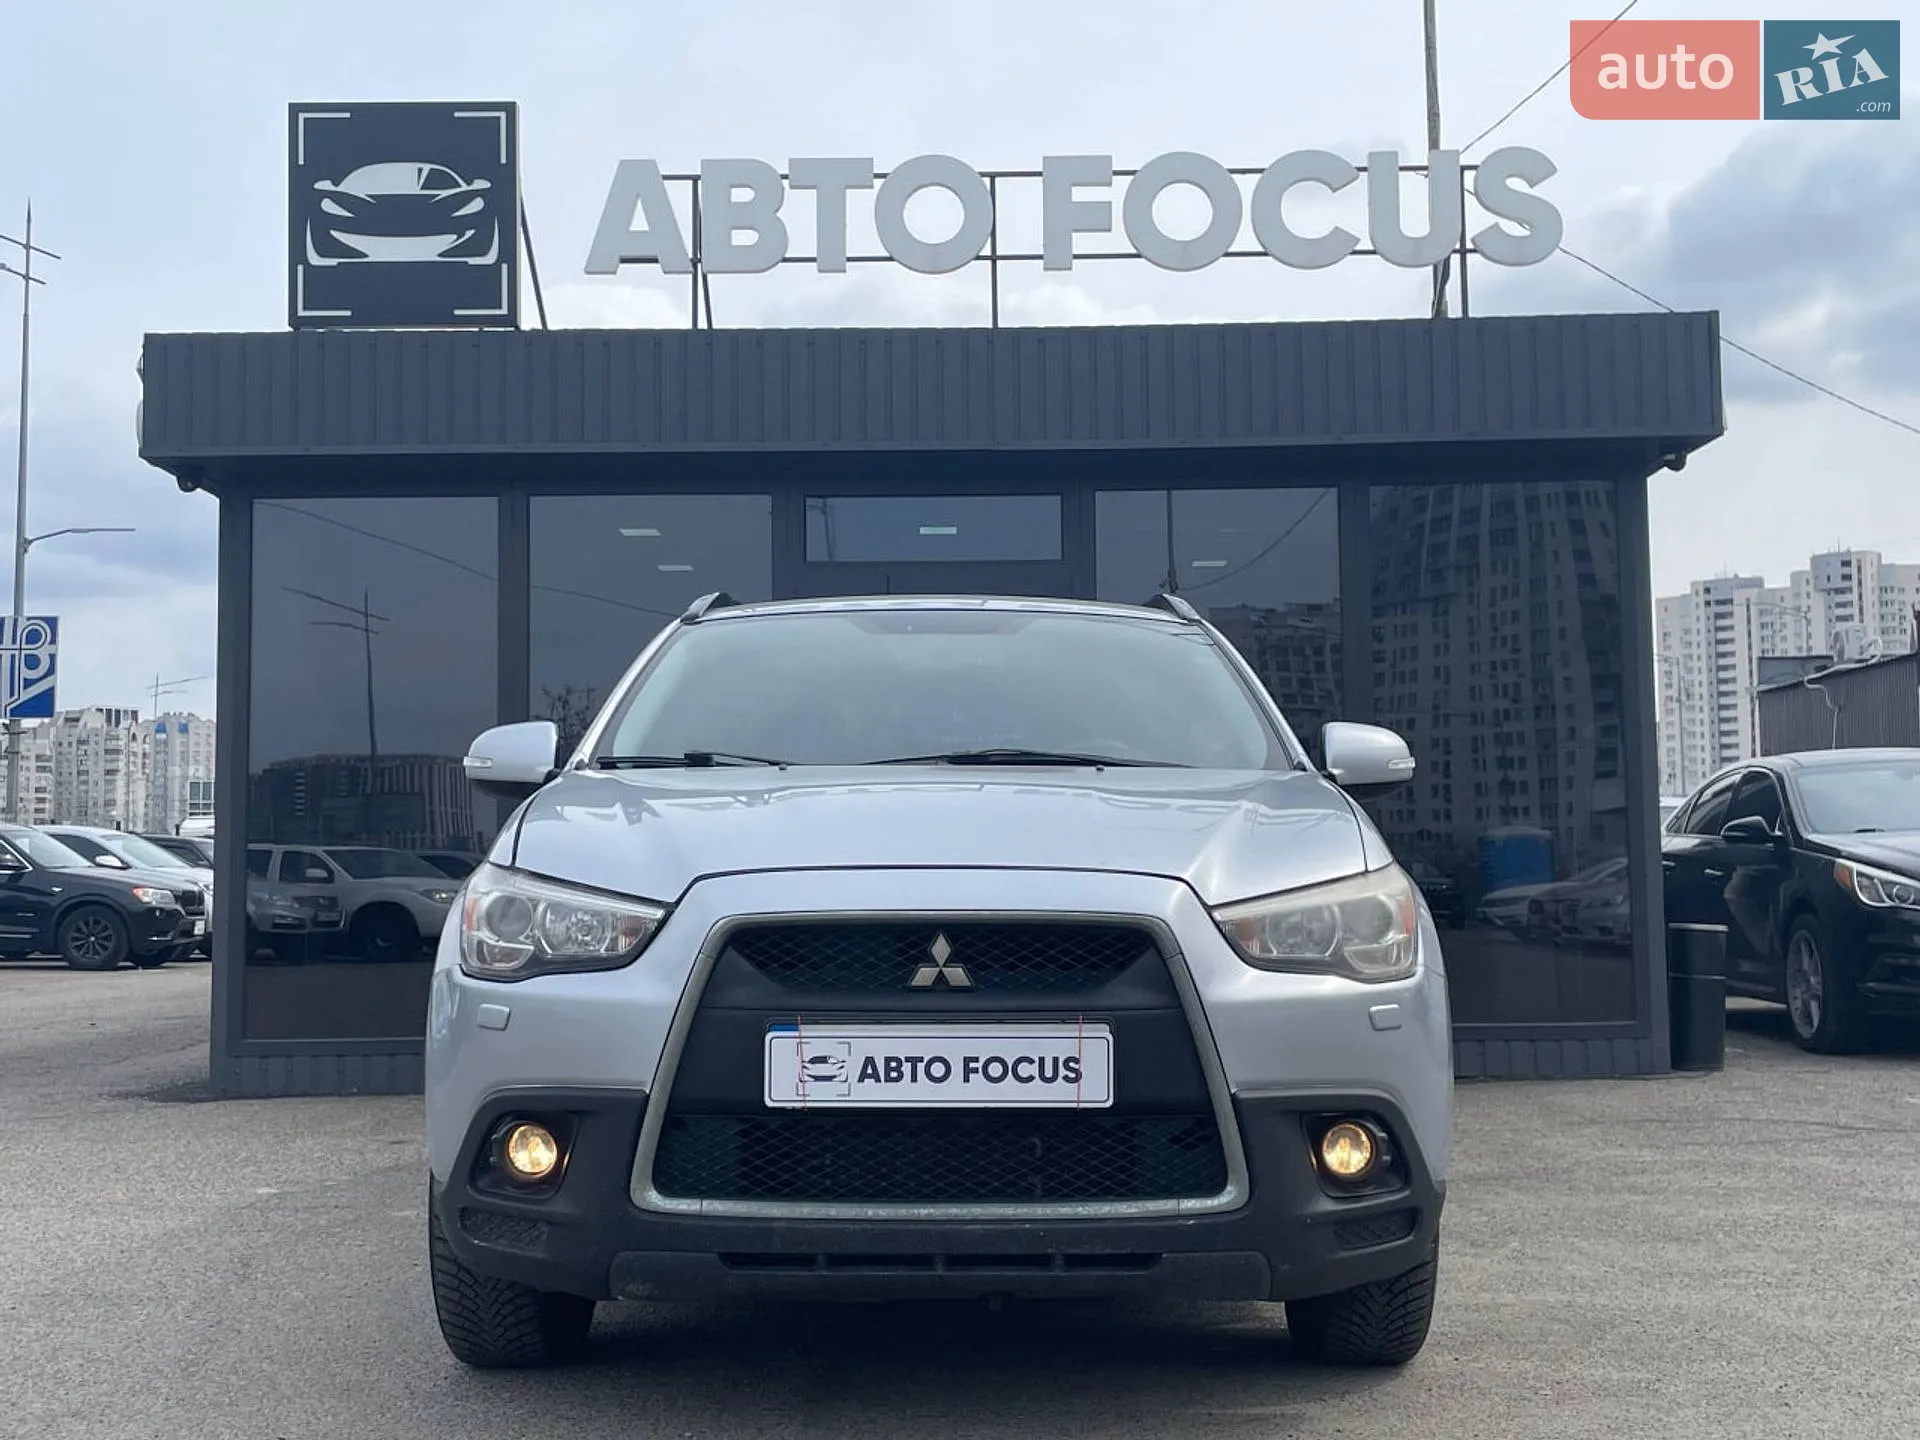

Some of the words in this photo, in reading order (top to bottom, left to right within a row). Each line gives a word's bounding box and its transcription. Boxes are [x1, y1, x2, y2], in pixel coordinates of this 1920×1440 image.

[584, 154, 994, 275] АВТО
[1043, 147, 1563, 271] FOCUS
[857, 1056, 952, 1084] АВТО
[963, 1056, 1083, 1084] FOCUS
